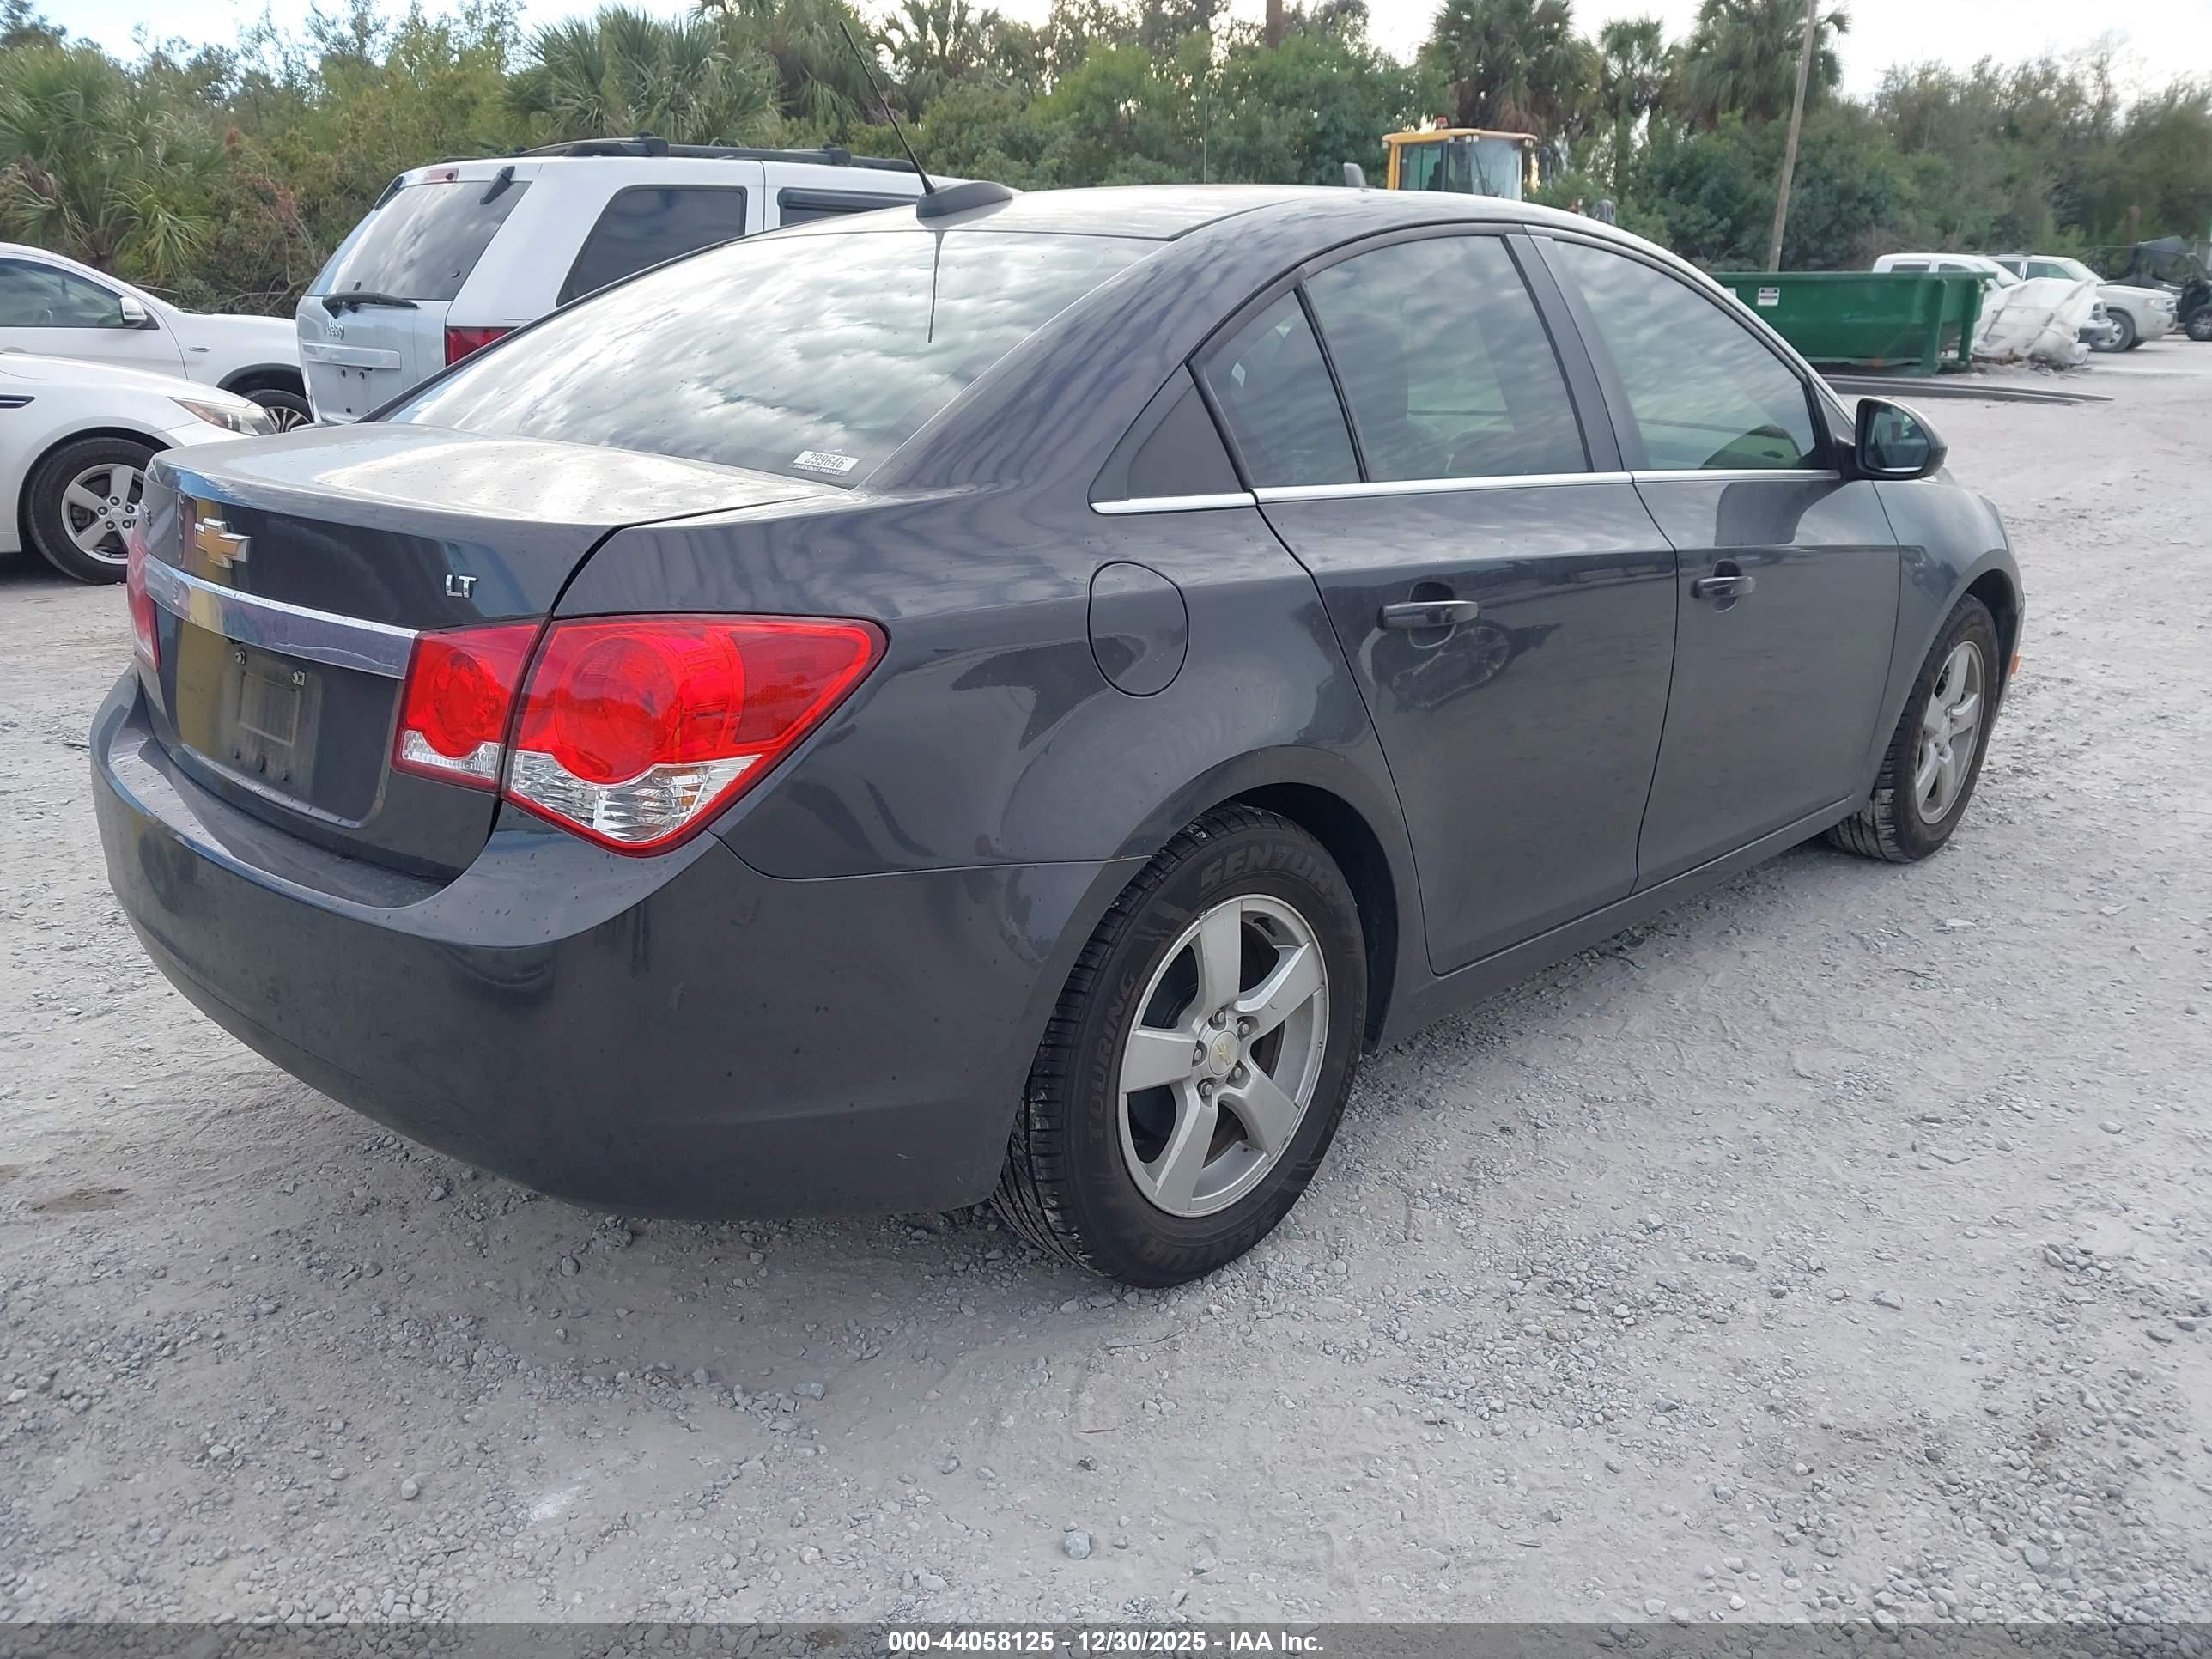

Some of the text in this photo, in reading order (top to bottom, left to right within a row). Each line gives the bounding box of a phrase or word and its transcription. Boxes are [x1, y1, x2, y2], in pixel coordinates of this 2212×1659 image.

[326, 320, 345, 340] Jeep
[805, 453, 848, 468] 299646
[445, 573, 478, 599] LT
[1085, 971, 1136, 1143] TOURING
